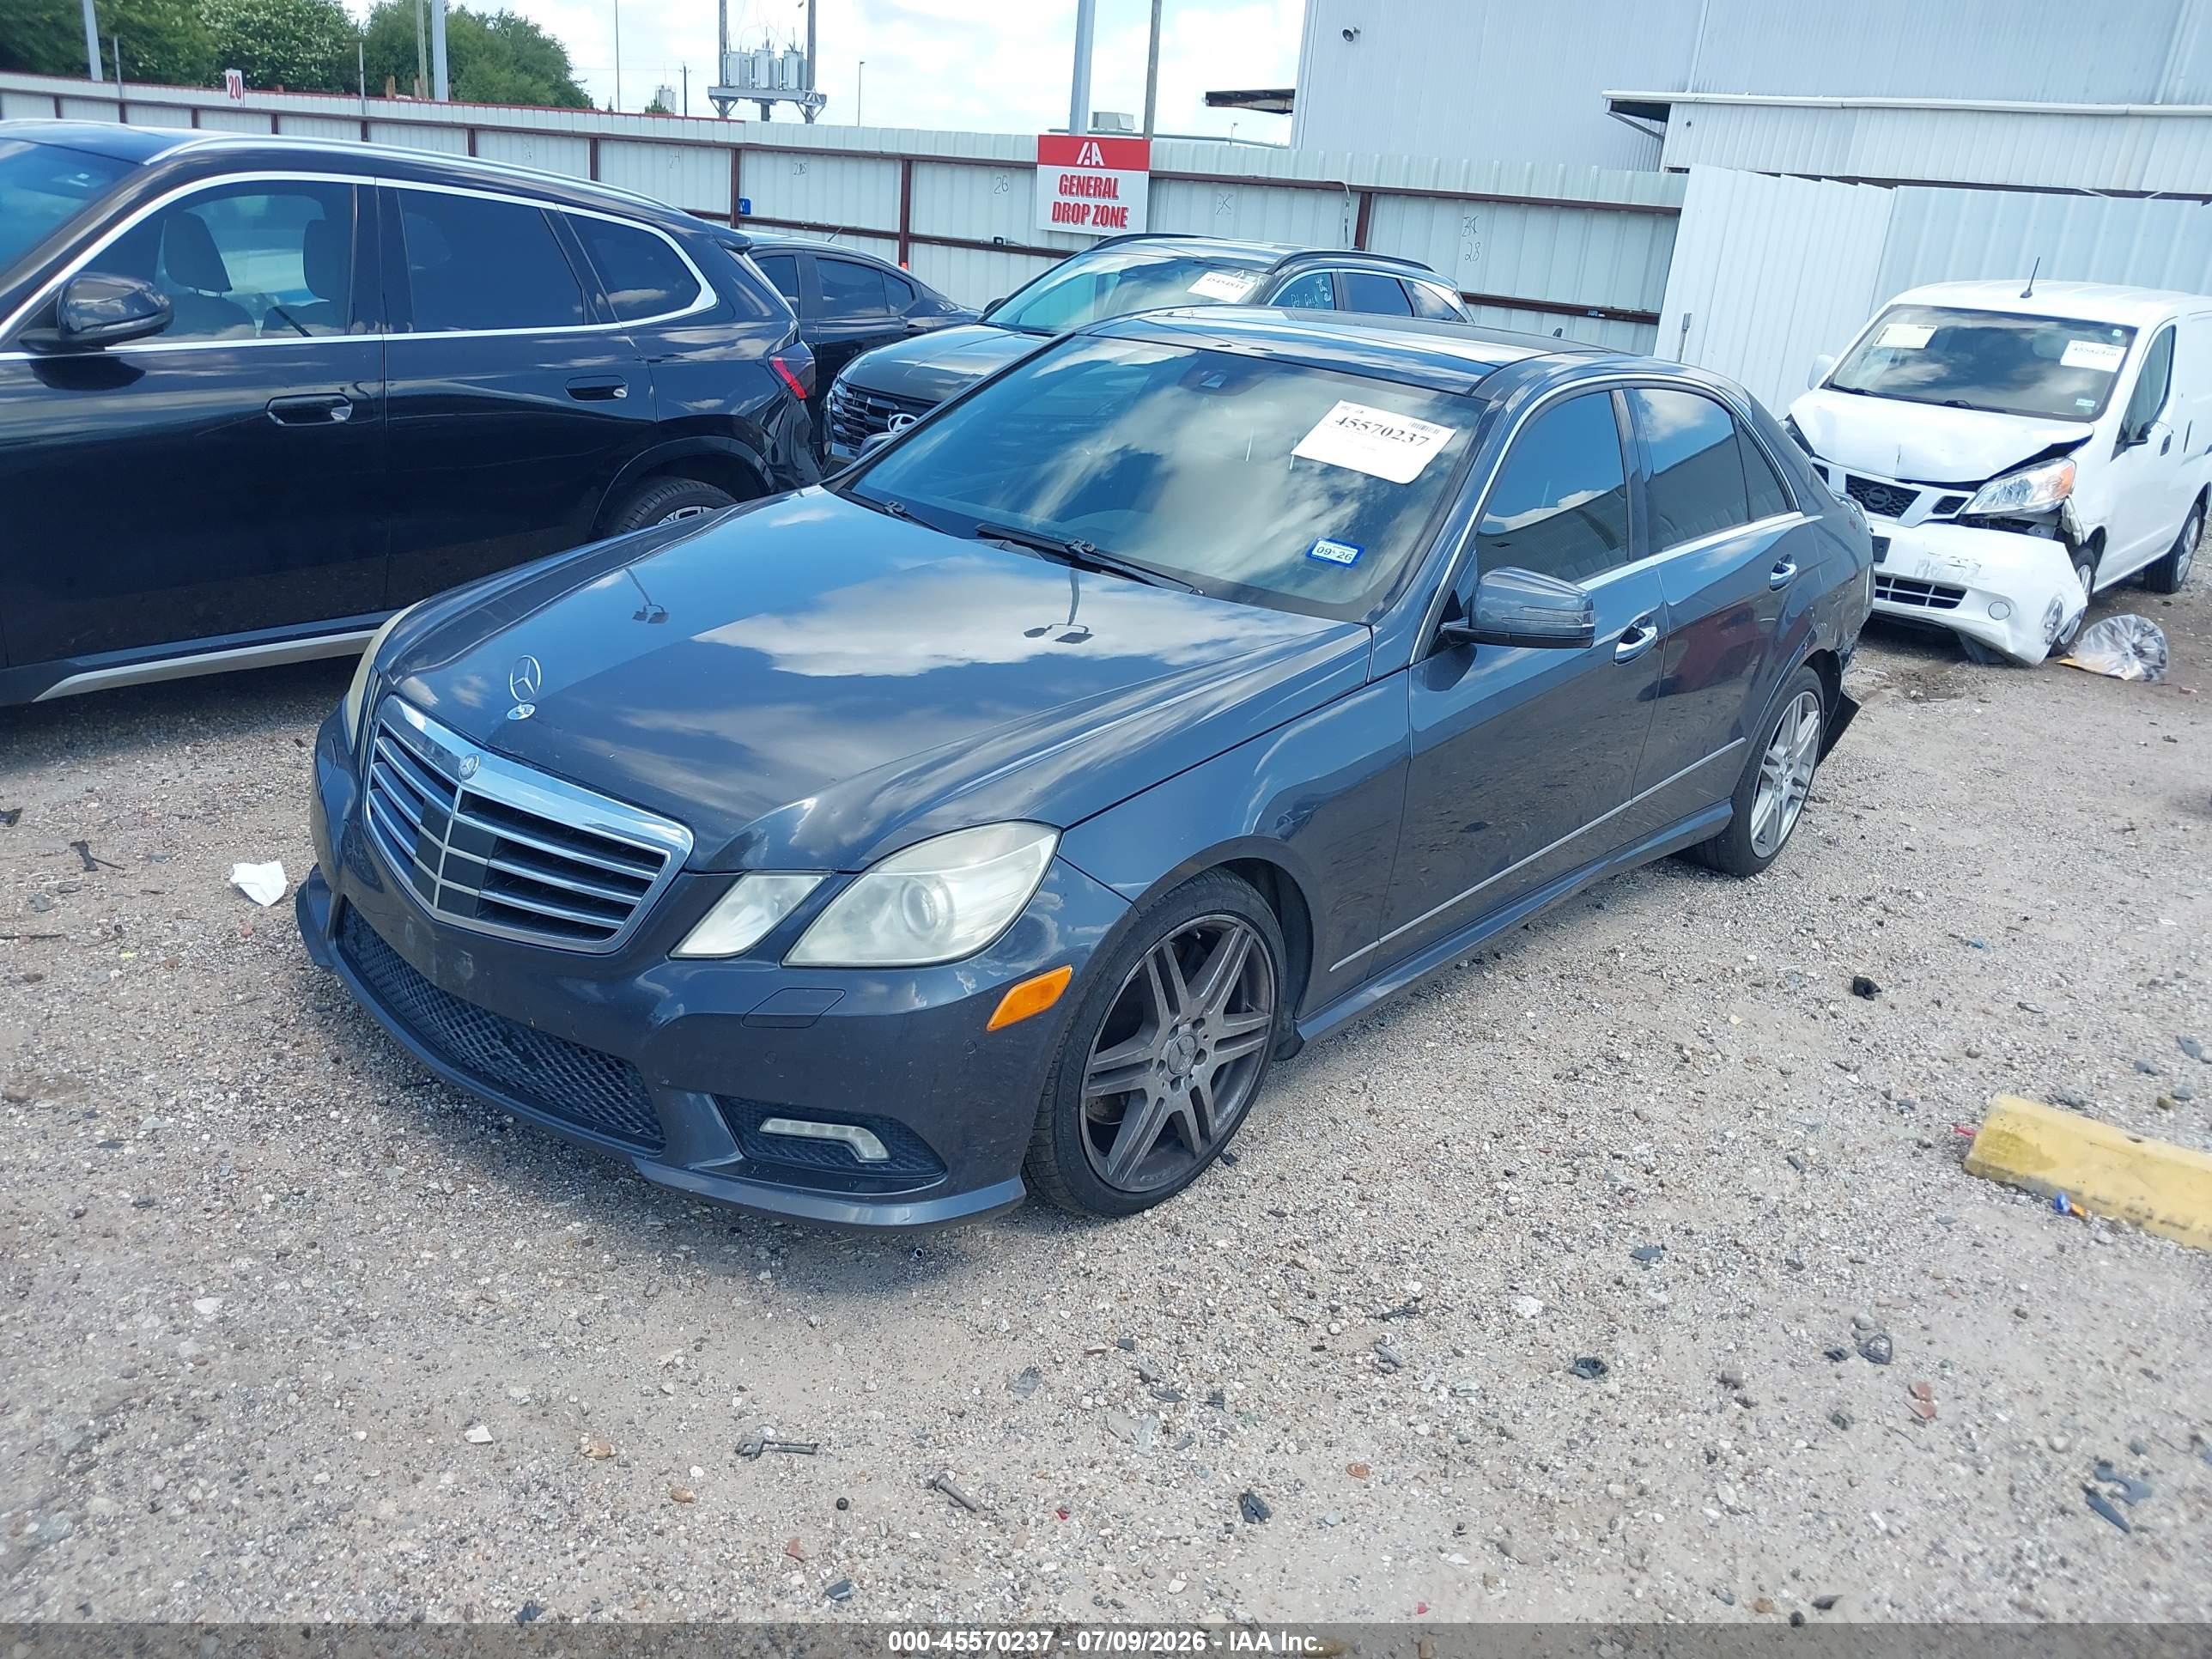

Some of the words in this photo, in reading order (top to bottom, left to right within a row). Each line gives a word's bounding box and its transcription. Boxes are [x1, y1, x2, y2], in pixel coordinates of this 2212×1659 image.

[228, 75, 241, 100] 20
[994, 174, 1009, 194] 26
[1059, 173, 1120, 200] GENERAL
[1052, 201, 1091, 225] DROP
[1091, 204, 1129, 229] ZONE
[1464, 241, 1480, 262] 28
[1334, 416, 1431, 447] 45570237
[1316, 546, 1333, 556] 09
[1335, 550, 1353, 561] 26
